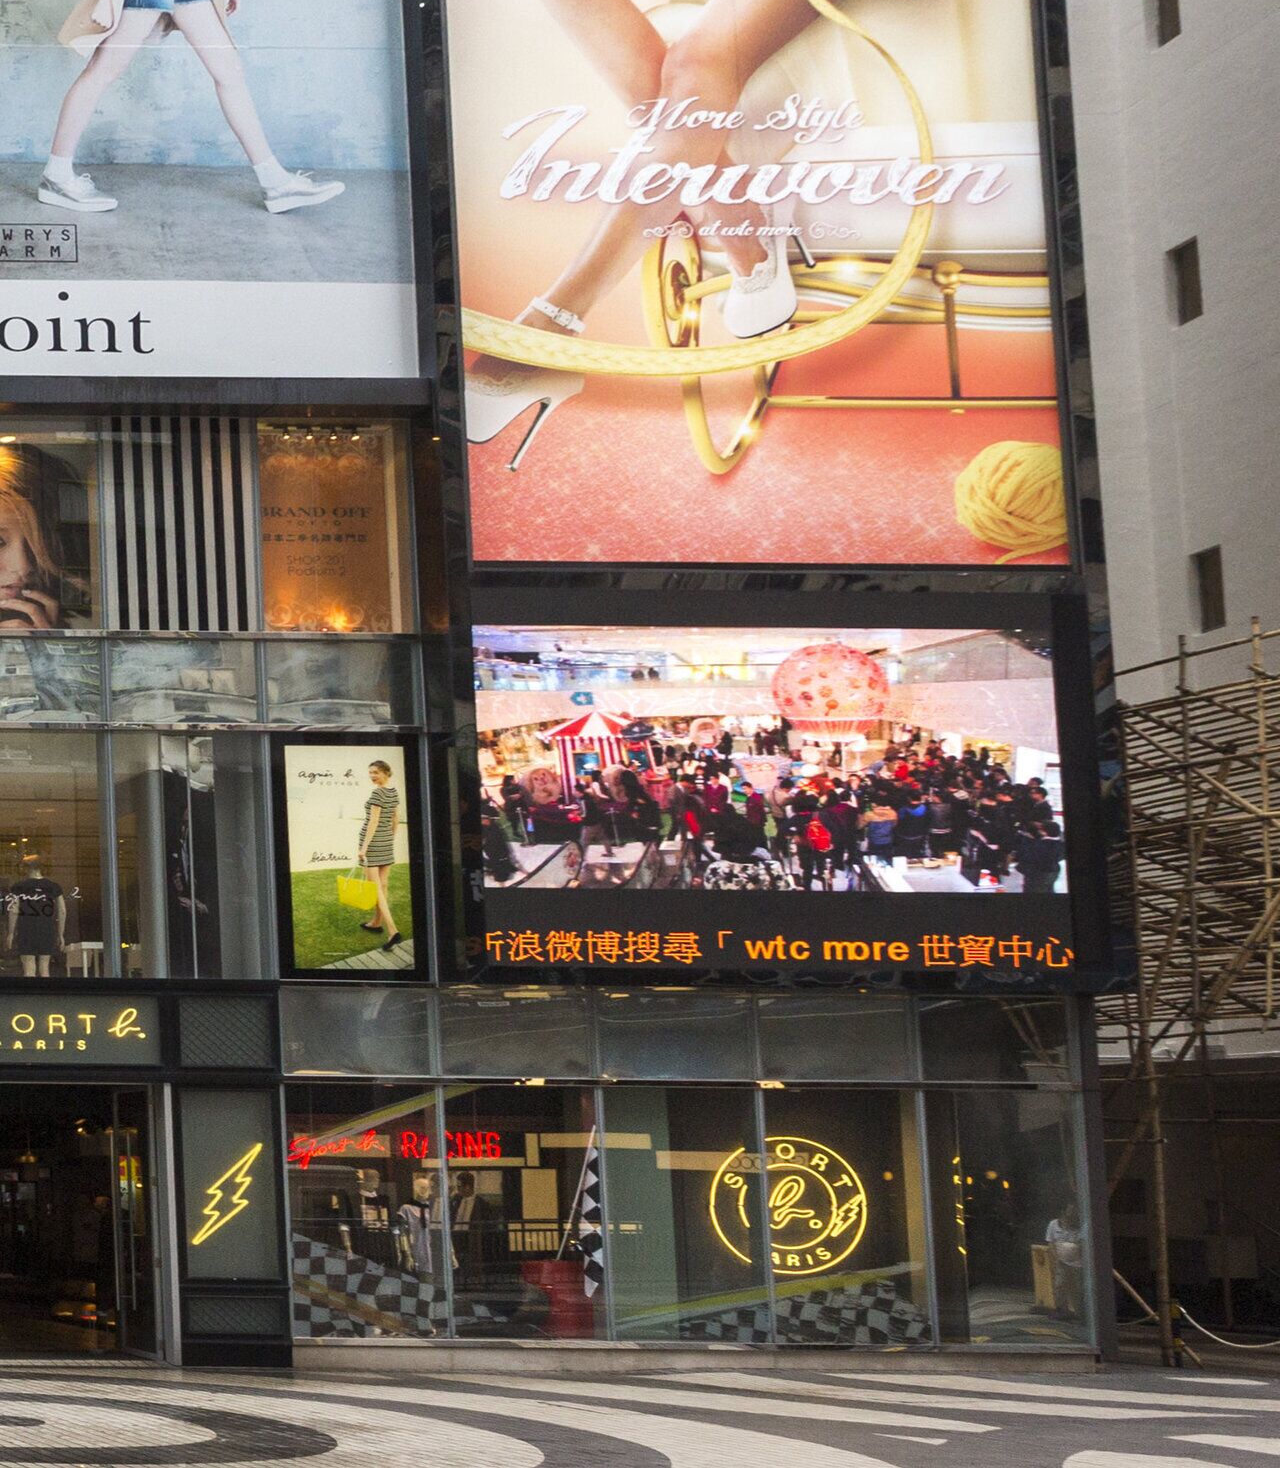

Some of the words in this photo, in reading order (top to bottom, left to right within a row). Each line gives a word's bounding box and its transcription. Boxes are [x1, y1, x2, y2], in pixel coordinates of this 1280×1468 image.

[625, 95, 746, 132] More
[751, 93, 867, 145] Style
[499, 103, 1013, 208] Interwoven
[260, 506, 326, 518] BRAND
[332, 506, 370, 518] OFF
[743, 935, 811, 962] wtc
[821, 940, 911, 963] more
[916, 934, 1076, 969] 世貿中心
